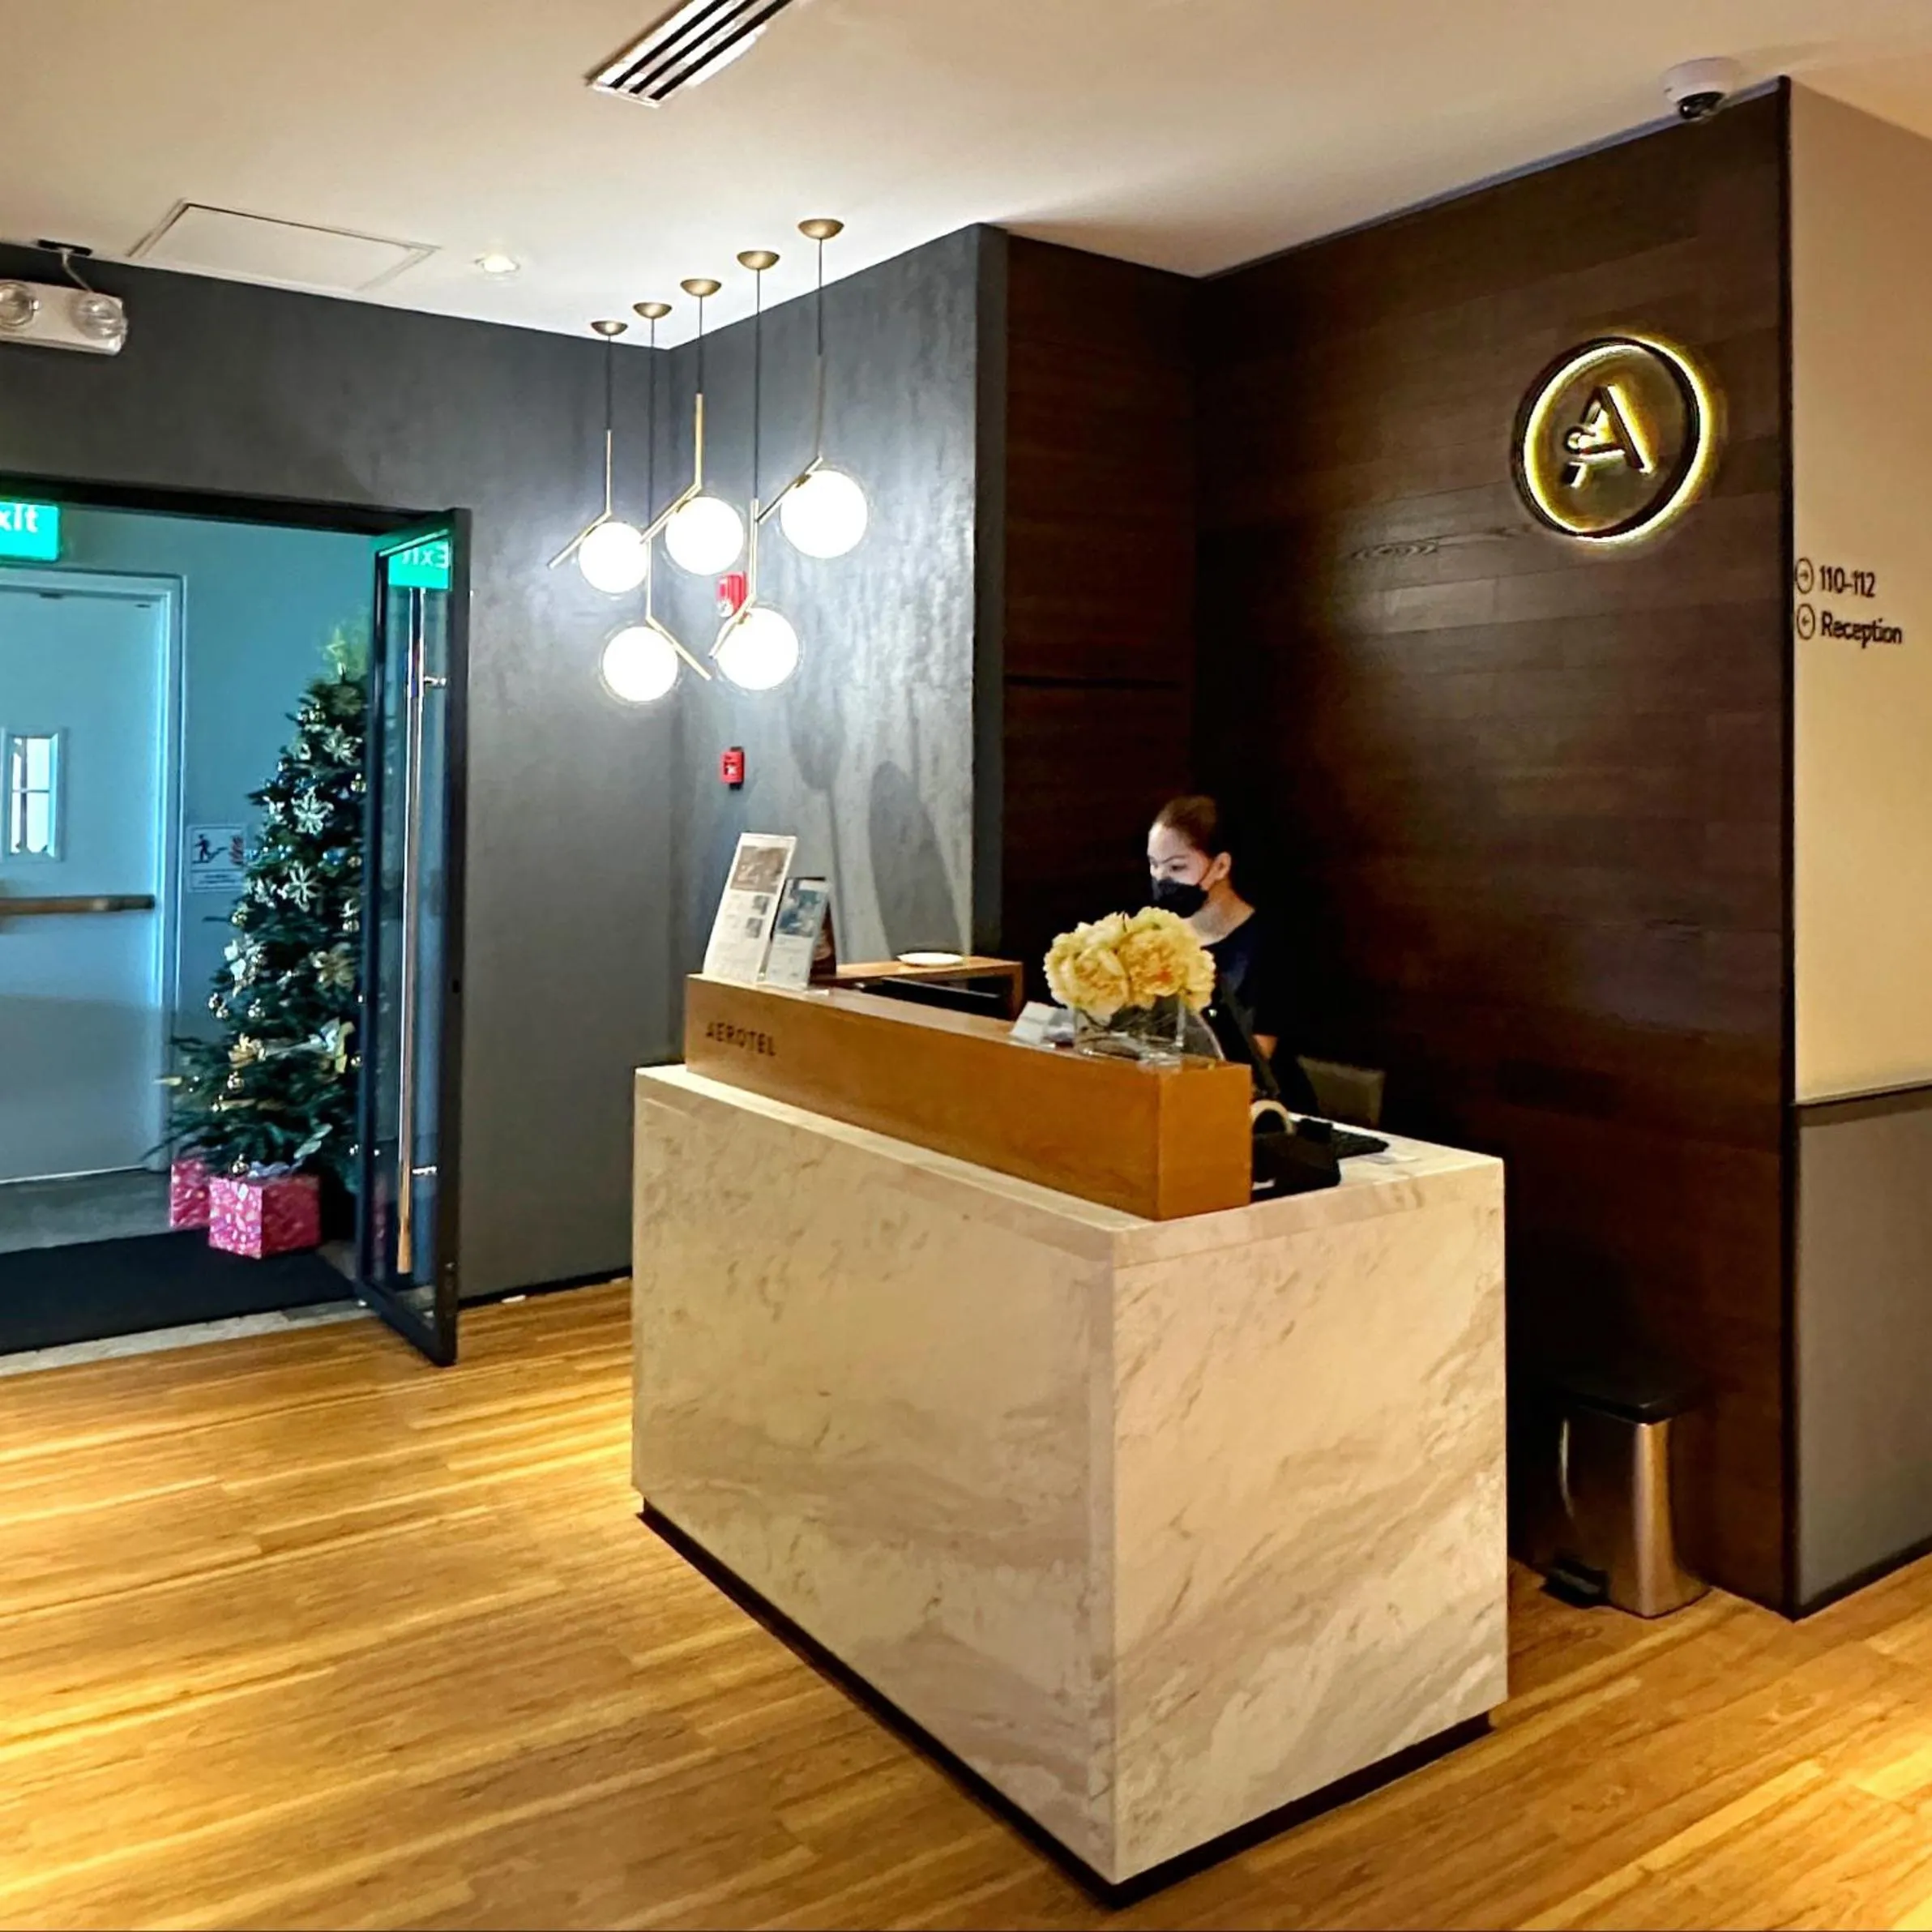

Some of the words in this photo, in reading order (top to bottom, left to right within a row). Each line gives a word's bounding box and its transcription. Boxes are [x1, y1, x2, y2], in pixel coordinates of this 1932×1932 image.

[1819, 566, 1875, 598] 110-112
[1821, 610, 1902, 649] Reception
[706, 1022, 776, 1057] AEROTEL
